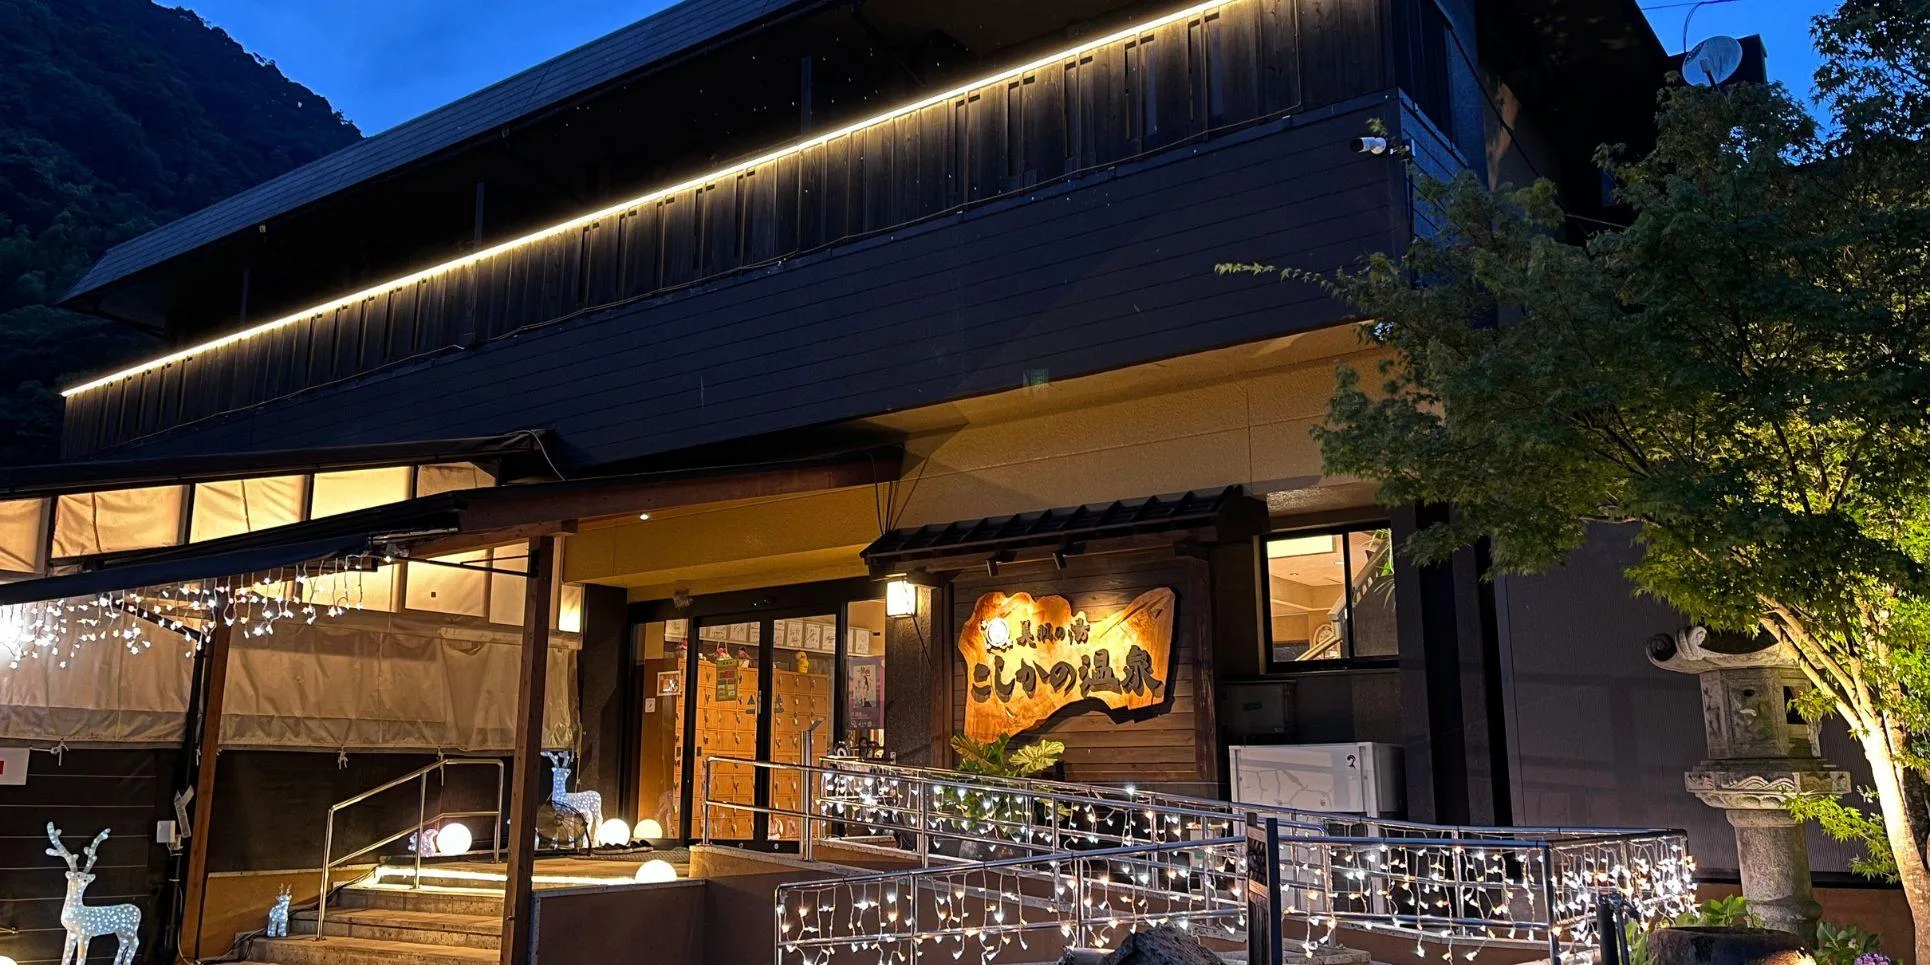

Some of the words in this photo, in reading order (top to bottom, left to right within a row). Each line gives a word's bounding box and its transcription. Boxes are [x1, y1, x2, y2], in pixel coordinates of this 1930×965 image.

[1016, 619, 1090, 648] 美肌の湯
[972, 645, 1163, 702] こしかの温泉
